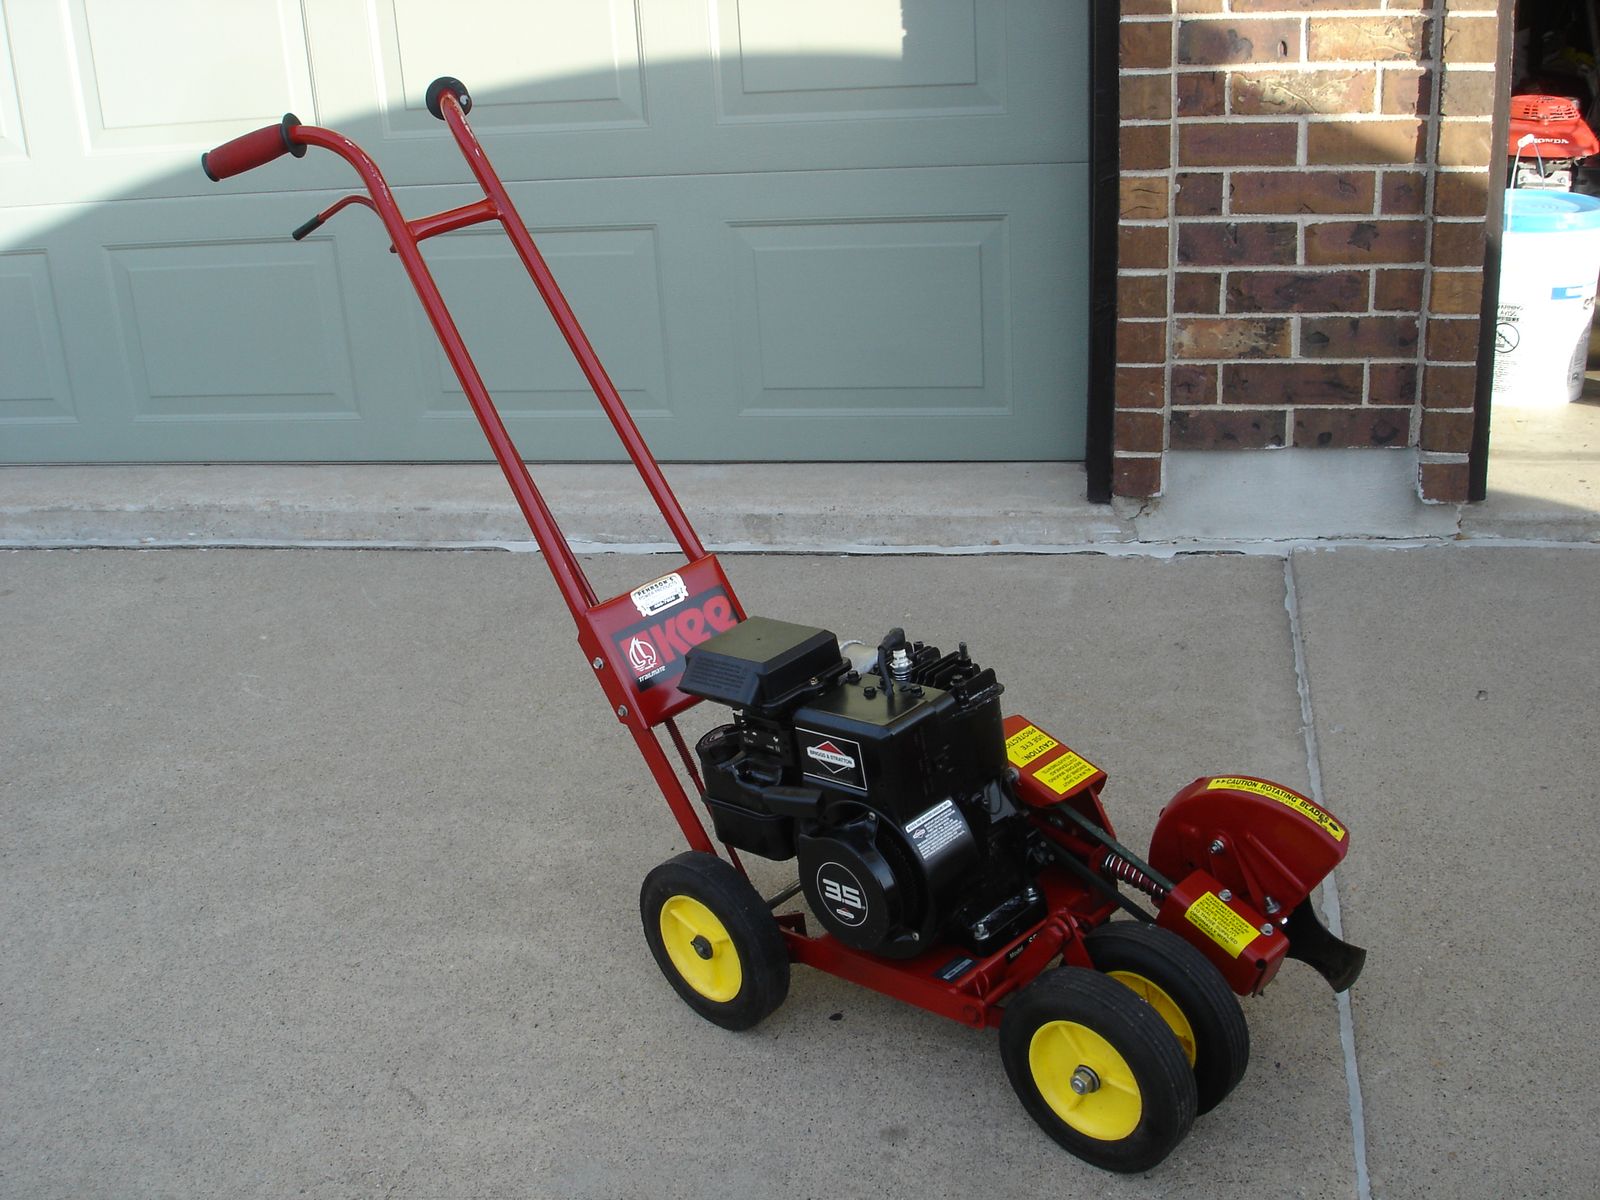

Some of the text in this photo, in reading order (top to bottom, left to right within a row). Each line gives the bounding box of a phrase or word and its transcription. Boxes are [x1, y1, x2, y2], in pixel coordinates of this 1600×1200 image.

[810, 750, 826, 759] BRIGGS
[830, 754, 853, 764] STRATTON
[1227, 779, 1330, 824] CAUTION ROTATING BLADES
[822, 878, 862, 909] 3.5
